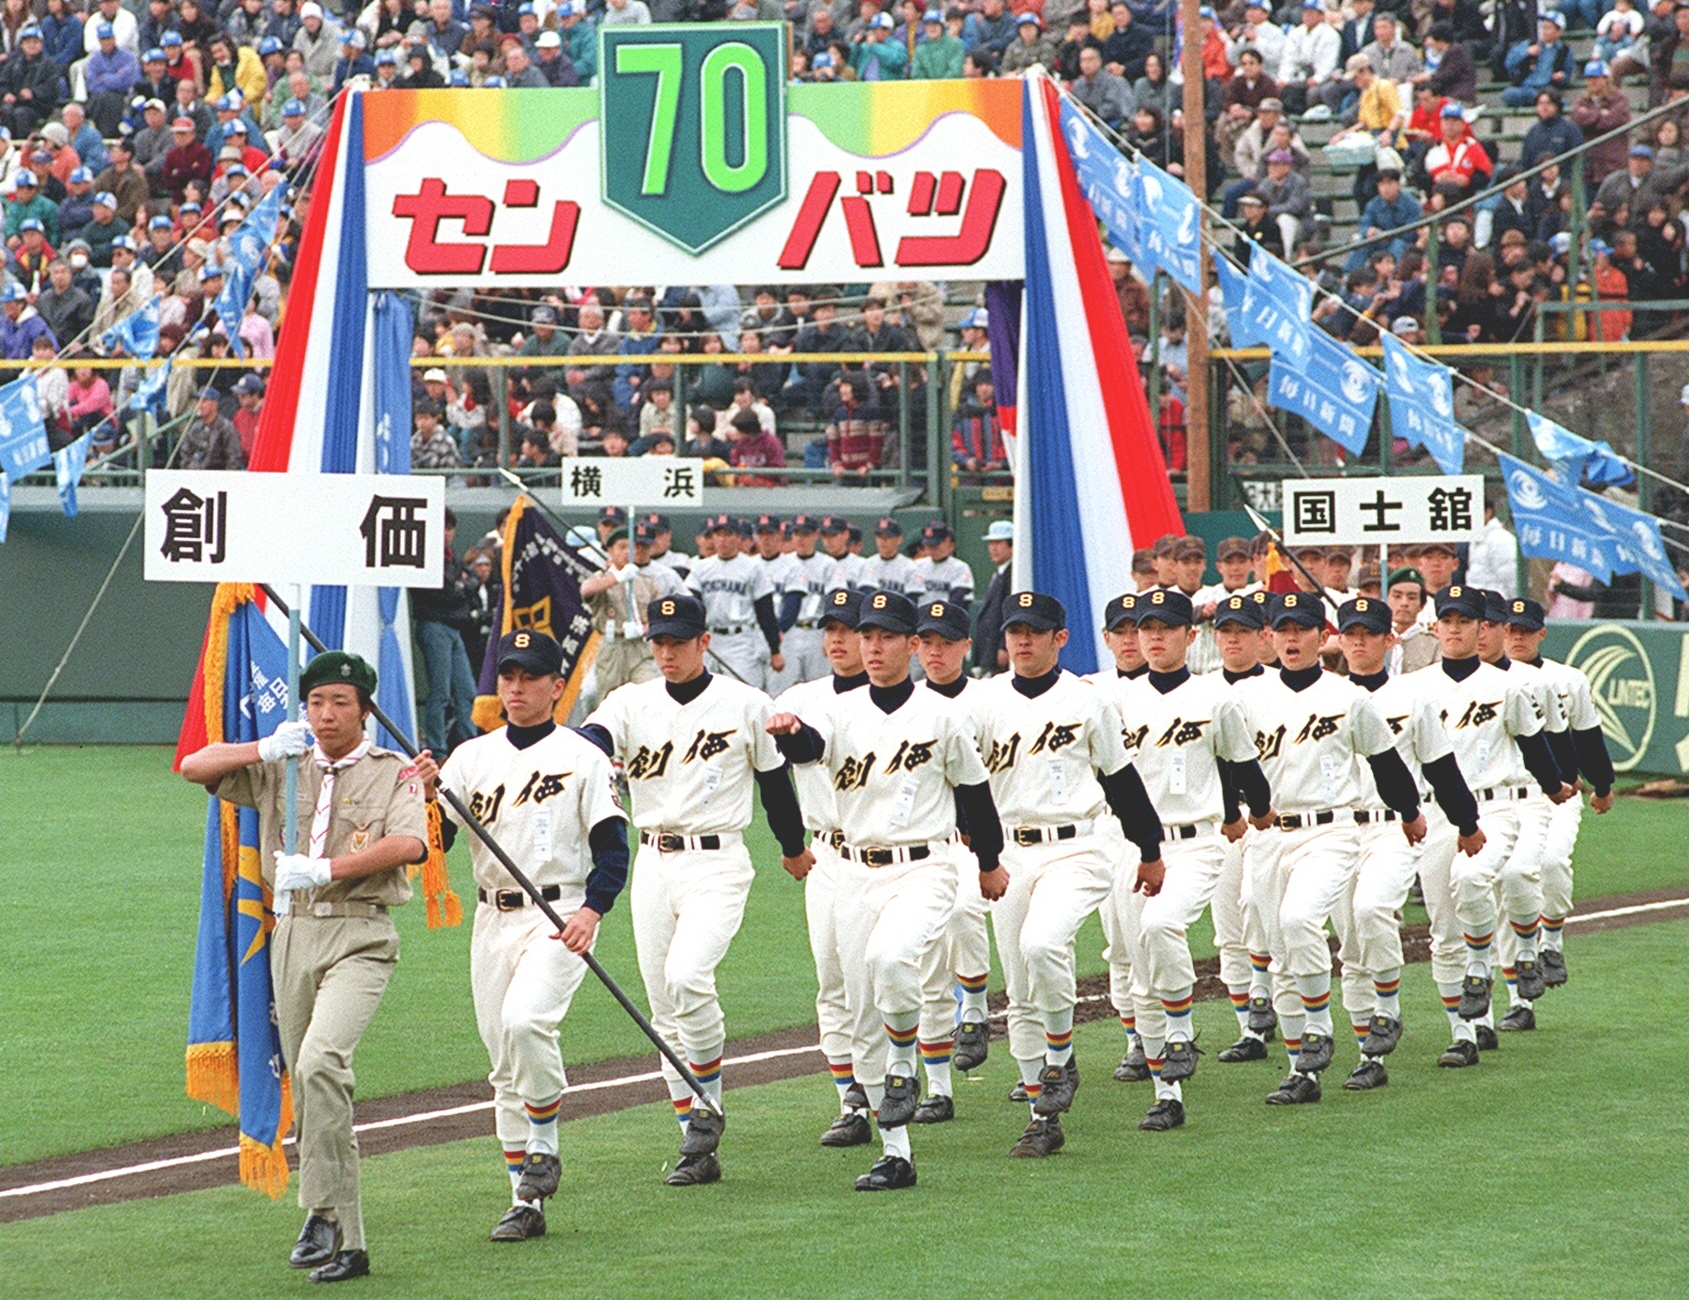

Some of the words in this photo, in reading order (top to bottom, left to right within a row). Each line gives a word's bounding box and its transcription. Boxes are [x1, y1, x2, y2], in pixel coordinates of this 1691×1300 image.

[615, 41, 768, 195] 70
[570, 465, 695, 498] 横浜
[159, 486, 428, 569] 創価
[661, 600, 675, 615] S
[872, 594, 887, 609] S
[1019, 593, 1033, 607] S
[1512, 601, 1525, 613] S
[514, 633, 530, 648] S
